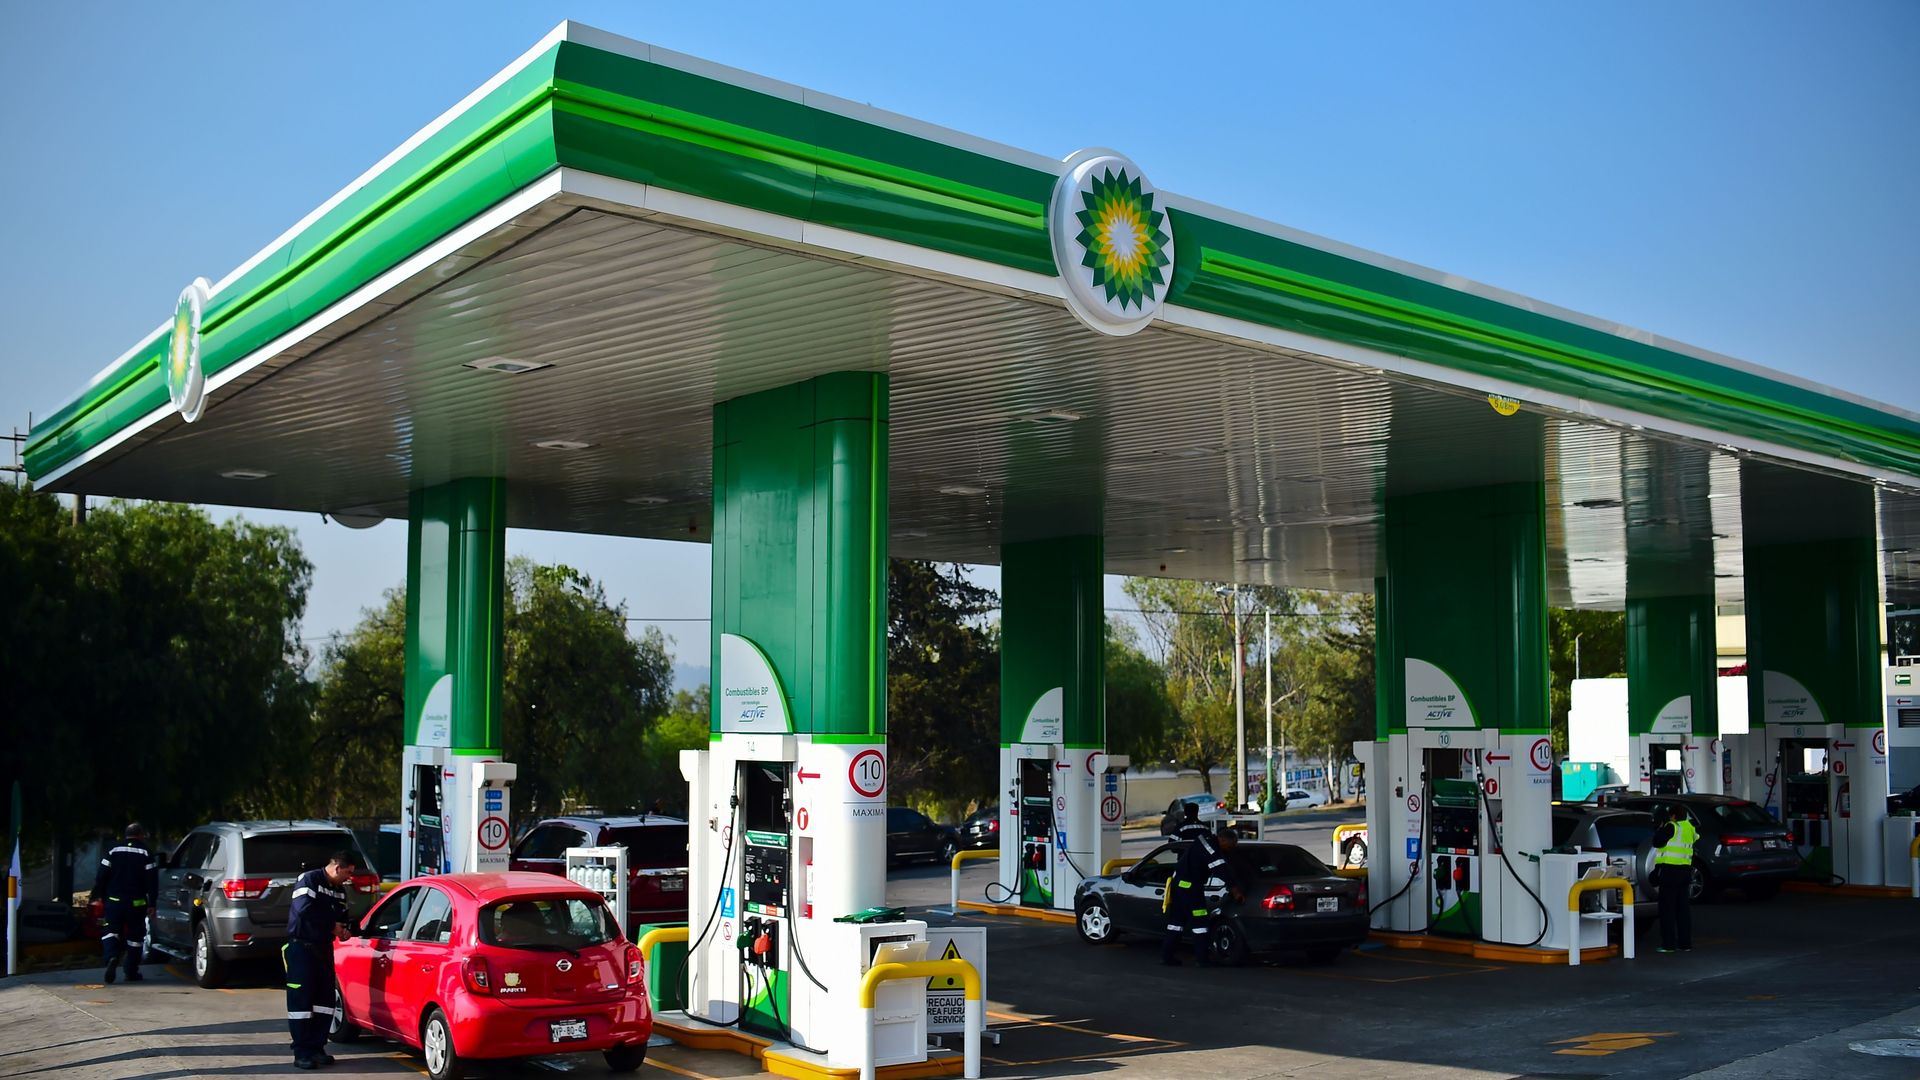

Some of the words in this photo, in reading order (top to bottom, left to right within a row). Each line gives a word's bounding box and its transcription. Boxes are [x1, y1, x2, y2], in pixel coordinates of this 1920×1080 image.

[725, 687, 760, 697] Combustibles
[761, 686, 769, 696] BP
[1410, 695, 1447, 703] Combustibles
[1447, 694, 1456, 702] BP
[740, 709, 766, 718] ACTIVE
[1440, 734, 1449, 745] 10
[1537, 745, 1550, 760] 10
[860, 760, 881, 780] 10
[852, 808, 885, 817] MAXIMA
[1105, 801, 1117, 813] 10
[485, 823, 502, 838] 10
[926, 997, 966, 1007] RECAUCI
[926, 1007, 941, 1016] REA
